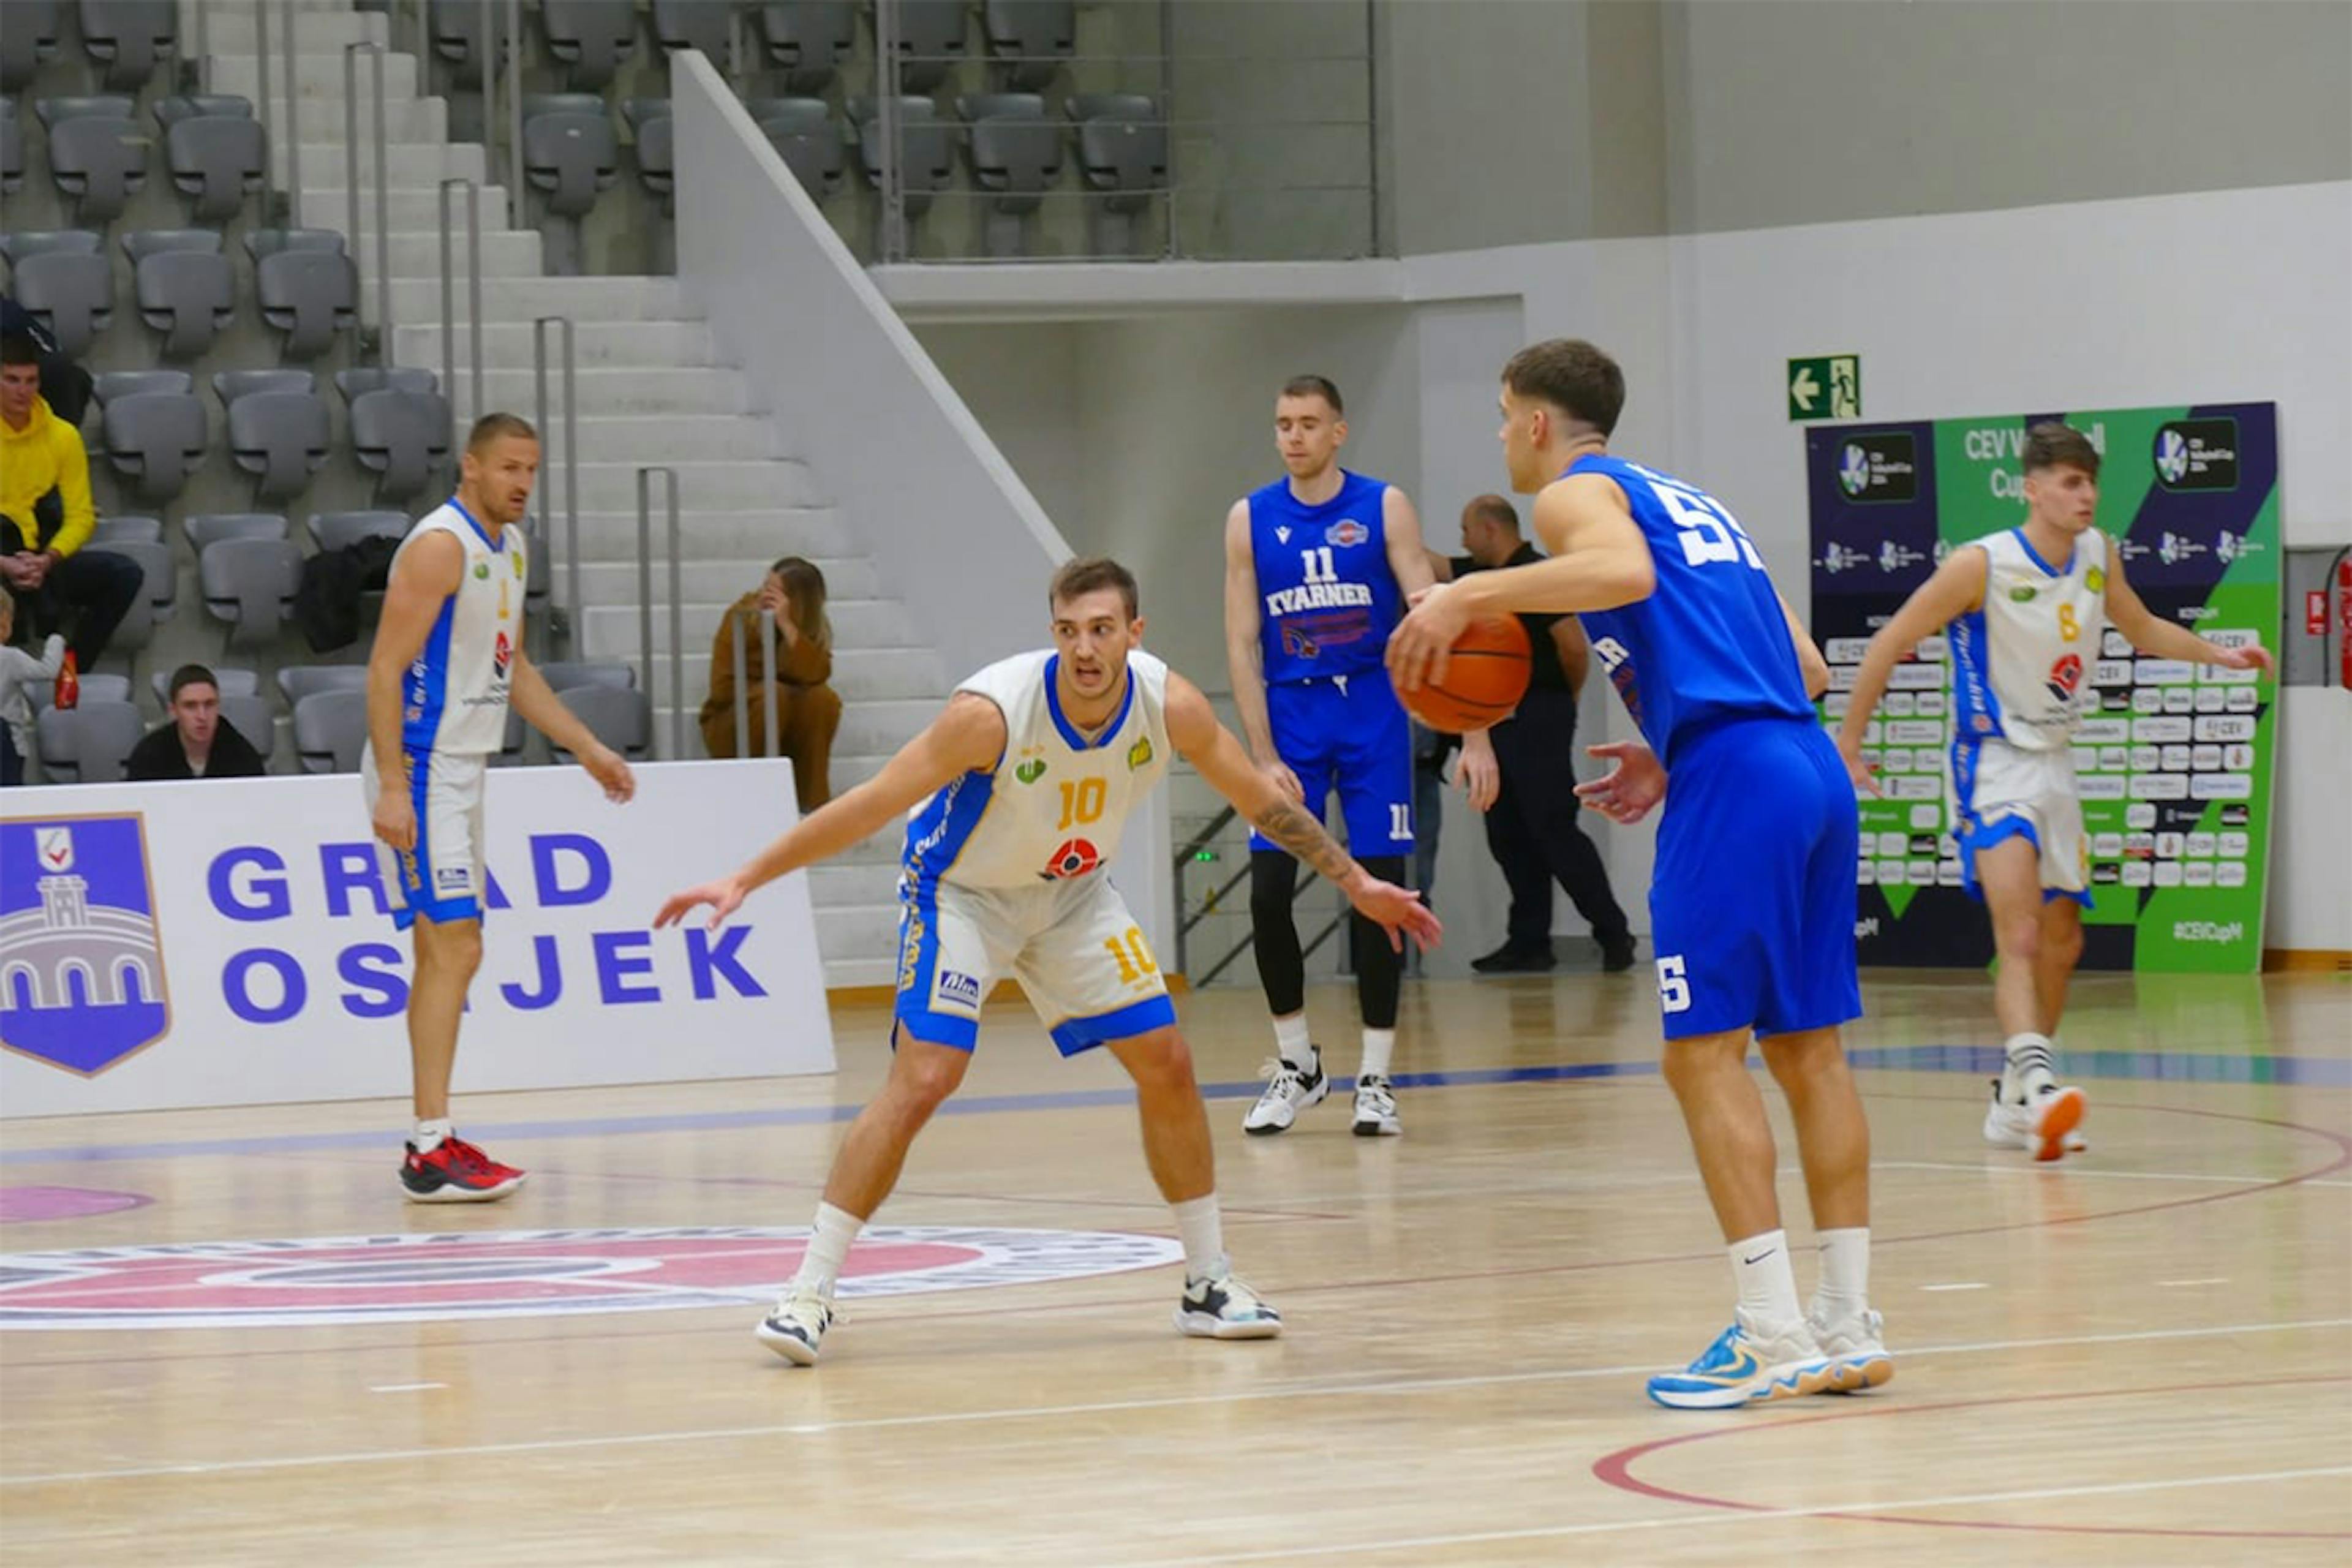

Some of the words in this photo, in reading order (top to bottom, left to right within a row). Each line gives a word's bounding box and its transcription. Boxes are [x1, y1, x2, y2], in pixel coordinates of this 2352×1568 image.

[1965, 429, 2007, 459] CEV
[1300, 546, 1338, 584] 11
[1265, 582, 1373, 617] KVARNER
[1057, 776, 1107, 831] 10
[1388, 803, 1415, 840] 11
[208, 833, 612, 921] GRD
[222, 924, 768, 1024] OSJEK
[1103, 925, 1157, 985] 10
